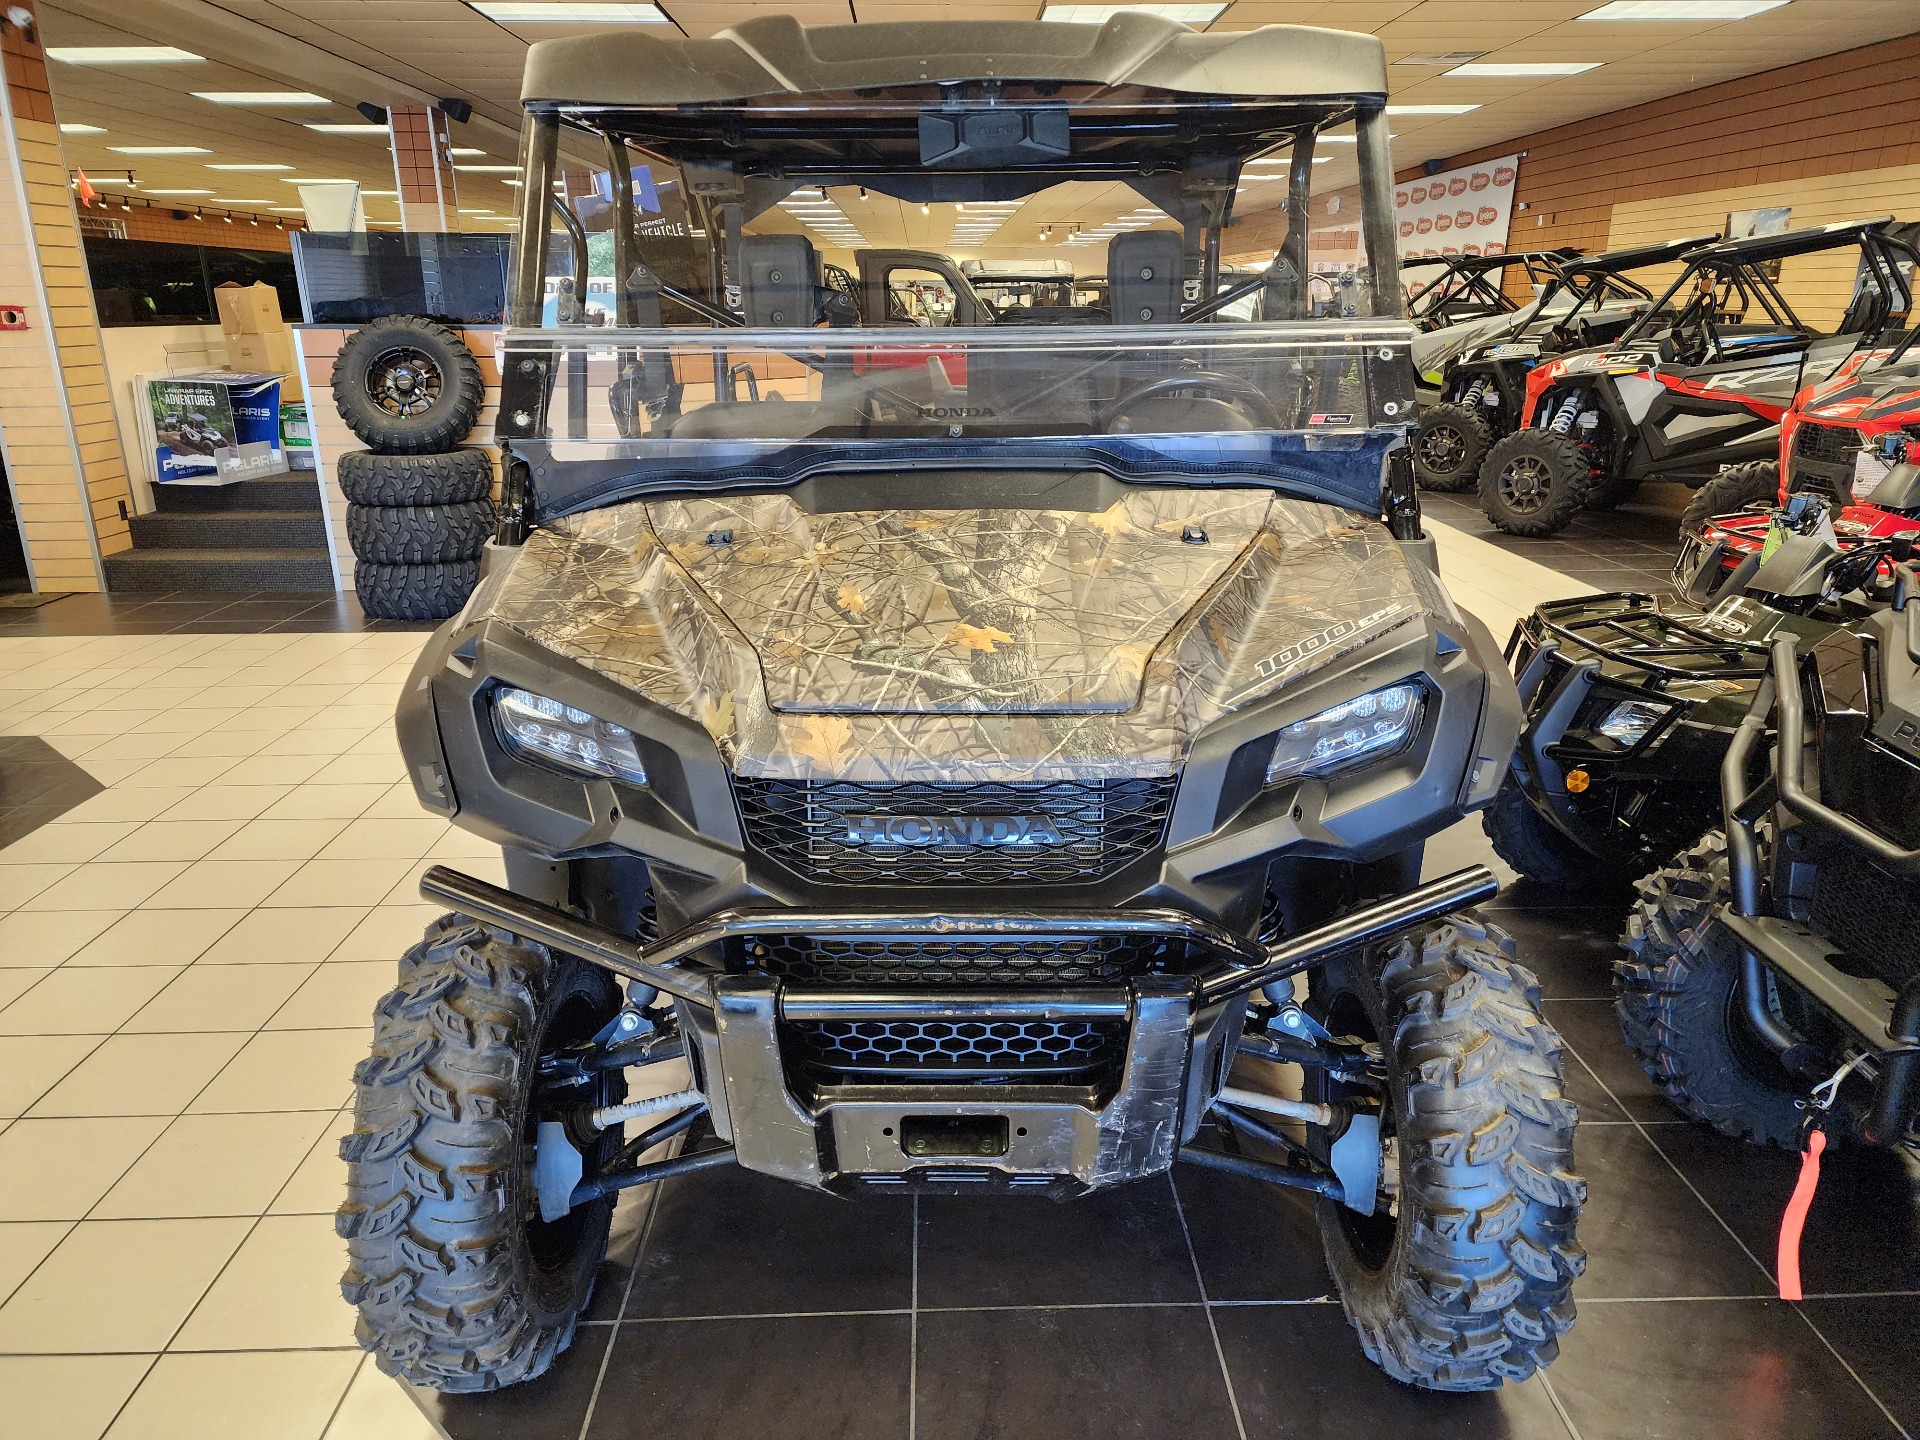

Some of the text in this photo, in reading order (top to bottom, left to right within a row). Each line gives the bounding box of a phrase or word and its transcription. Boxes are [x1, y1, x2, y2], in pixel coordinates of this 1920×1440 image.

[589, 282, 613, 293] OF
[1582, 353, 1644, 368] 1000
[165, 393, 216, 406] ADVENTURES
[231, 406, 271, 417] LARIS
[917, 407, 997, 418] HONDA
[177, 467, 197, 476] HOLIDAY
[1255, 602, 1402, 678] 1000 EPS
[845, 814, 1066, 846] HONDA
